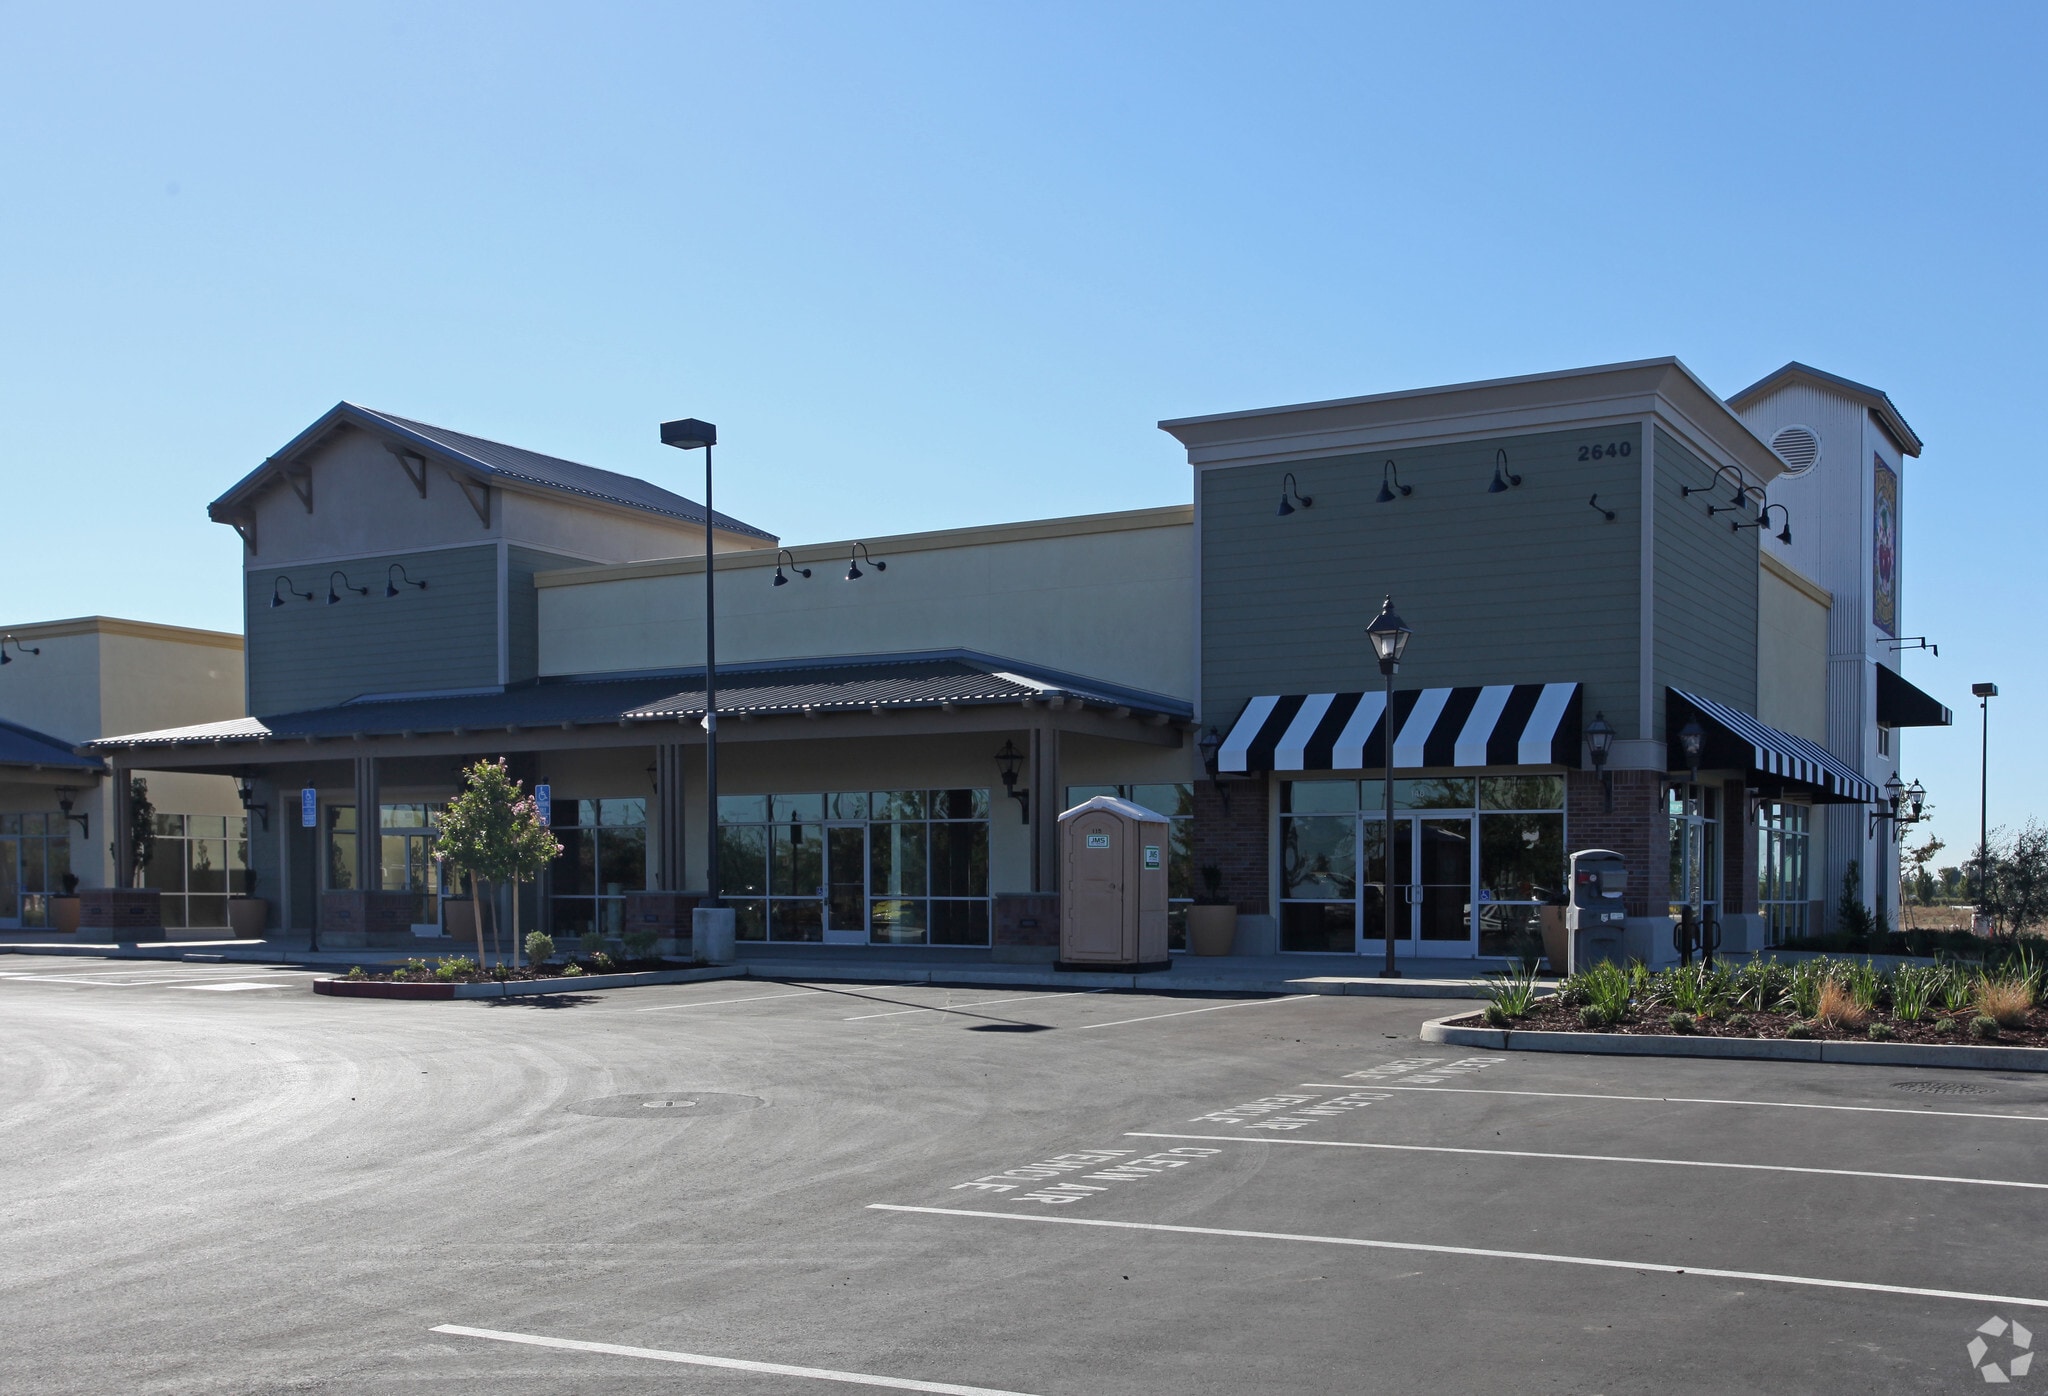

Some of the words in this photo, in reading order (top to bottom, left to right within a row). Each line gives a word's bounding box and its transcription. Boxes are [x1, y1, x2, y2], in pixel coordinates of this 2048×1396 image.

[1578, 441, 1631, 461] 2640
[1188, 1094, 1322, 1123] VEHICLE
[1290, 1092, 1394, 1115] CLEAN
[1244, 1116, 1319, 1130] AIR
[950, 1150, 1136, 1193] VEHICLE
[1081, 1147, 1222, 1181] CLEAN
[1009, 1182, 1109, 1204] AIR
